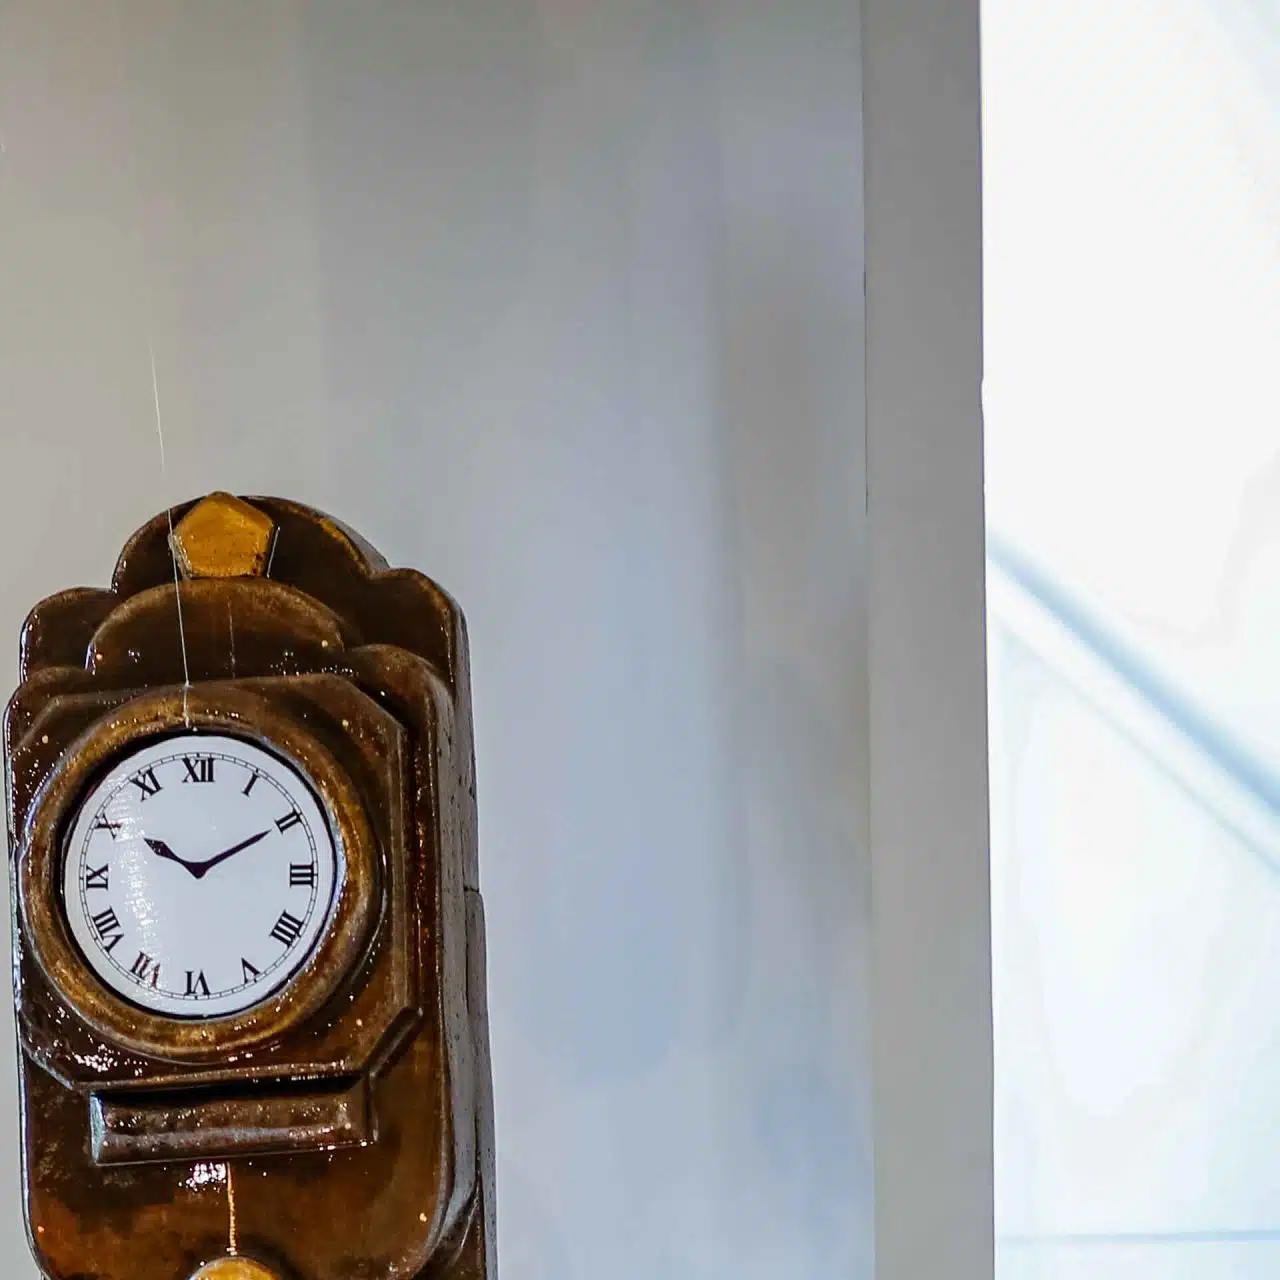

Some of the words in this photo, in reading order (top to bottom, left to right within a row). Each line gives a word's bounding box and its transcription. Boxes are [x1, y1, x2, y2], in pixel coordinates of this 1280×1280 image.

[182, 757, 215, 783] XII
[130, 768, 163, 801] XI
[241, 772, 261, 797] I
[275, 808, 303, 834] II
[86, 864, 109, 890] IX
[289, 863, 314, 888] III
[184, 969, 210, 996] VI
[241, 957, 261, 984] V
